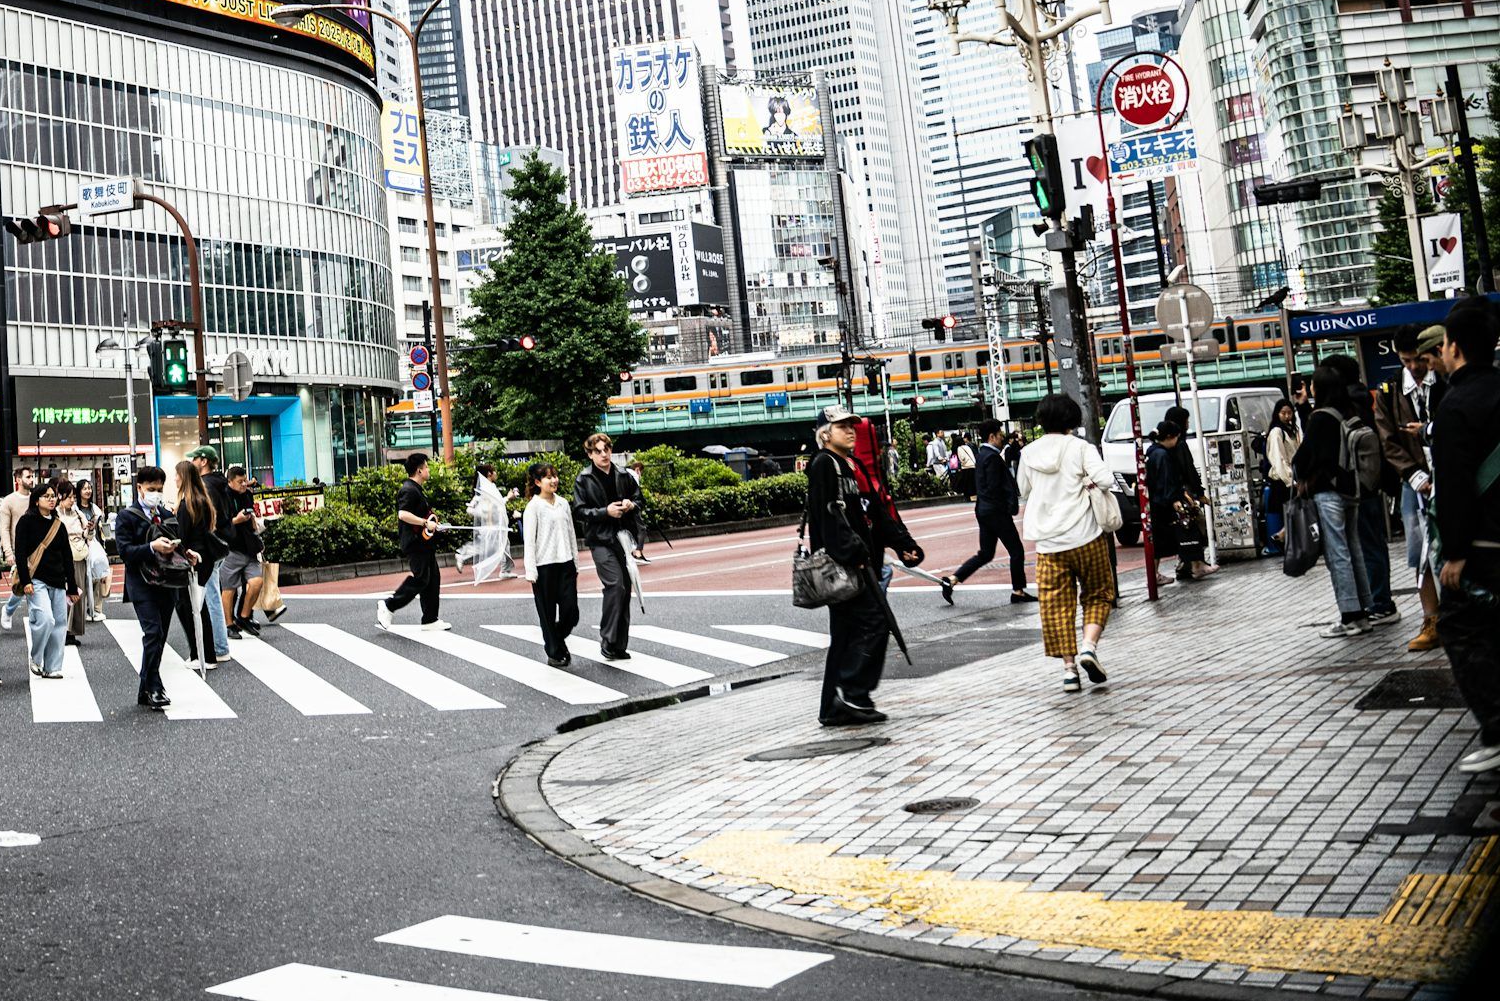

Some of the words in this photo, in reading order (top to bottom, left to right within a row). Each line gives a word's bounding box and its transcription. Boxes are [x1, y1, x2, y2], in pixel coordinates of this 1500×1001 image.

[616, 44, 692, 90] カラオケ
[1120, 73, 1135, 83] FIRE
[1135, 69, 1163, 80] HYDRANT
[649, 89, 665, 112] の
[1117, 79, 1172, 111] 消火栓
[389, 109, 419, 137] プロ
[628, 111, 692, 153] 鉄人
[393, 142, 421, 166] ミス
[1132, 134, 1197, 159] セキネ
[1127, 152, 1191, 171] 03-3352-7325
[627, 170, 706, 190] 03-3345-6430
[82, 181, 128, 201] 歌舞伎町
[91, 199, 120, 209] Kabukicho
[694, 249, 725, 265] WILLROSE
[1430, 238, 1441, 258] I
[1432, 275, 1460, 285] 歌舞伎町
[1300, 312, 1378, 334] SUBNADE
[114, 456, 130, 464] TAXI
